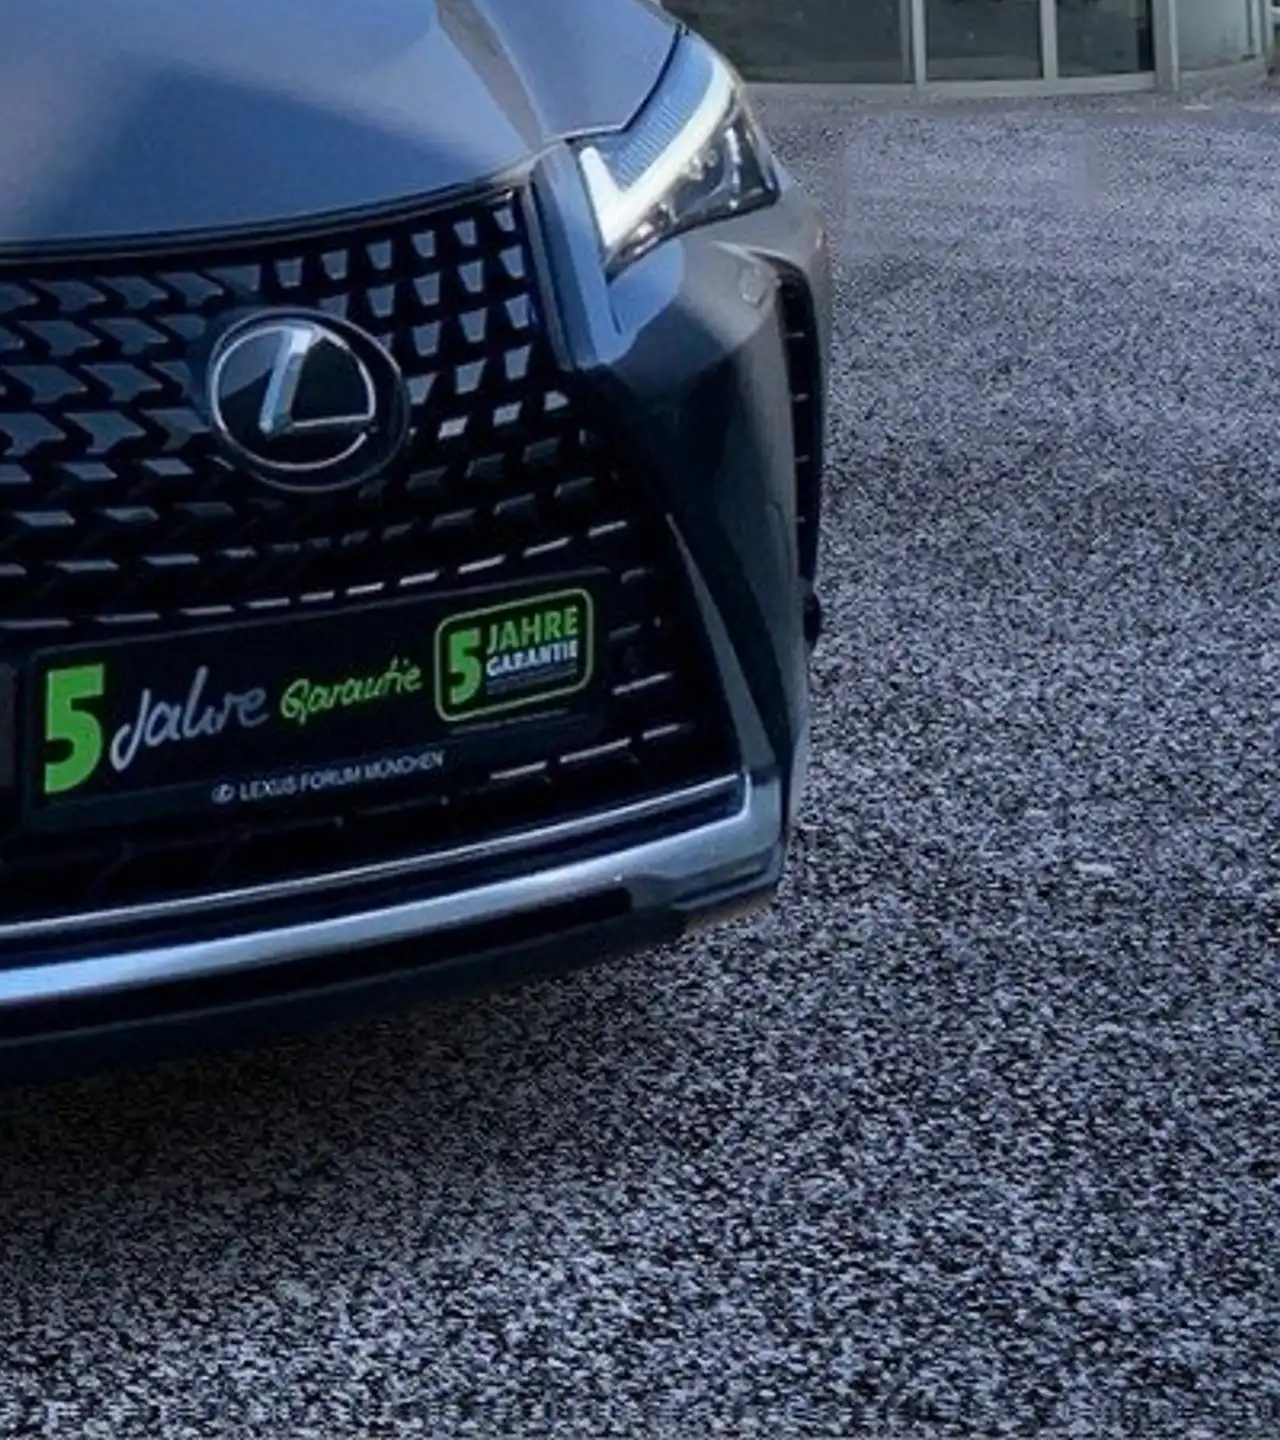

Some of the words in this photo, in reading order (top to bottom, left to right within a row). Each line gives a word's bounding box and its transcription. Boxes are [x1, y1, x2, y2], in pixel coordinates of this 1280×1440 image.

[448, 627, 481, 704] 5
[486, 605, 578, 656] JAHRE
[44, 663, 104, 794] 5
[279, 657, 423, 725] Garantie
